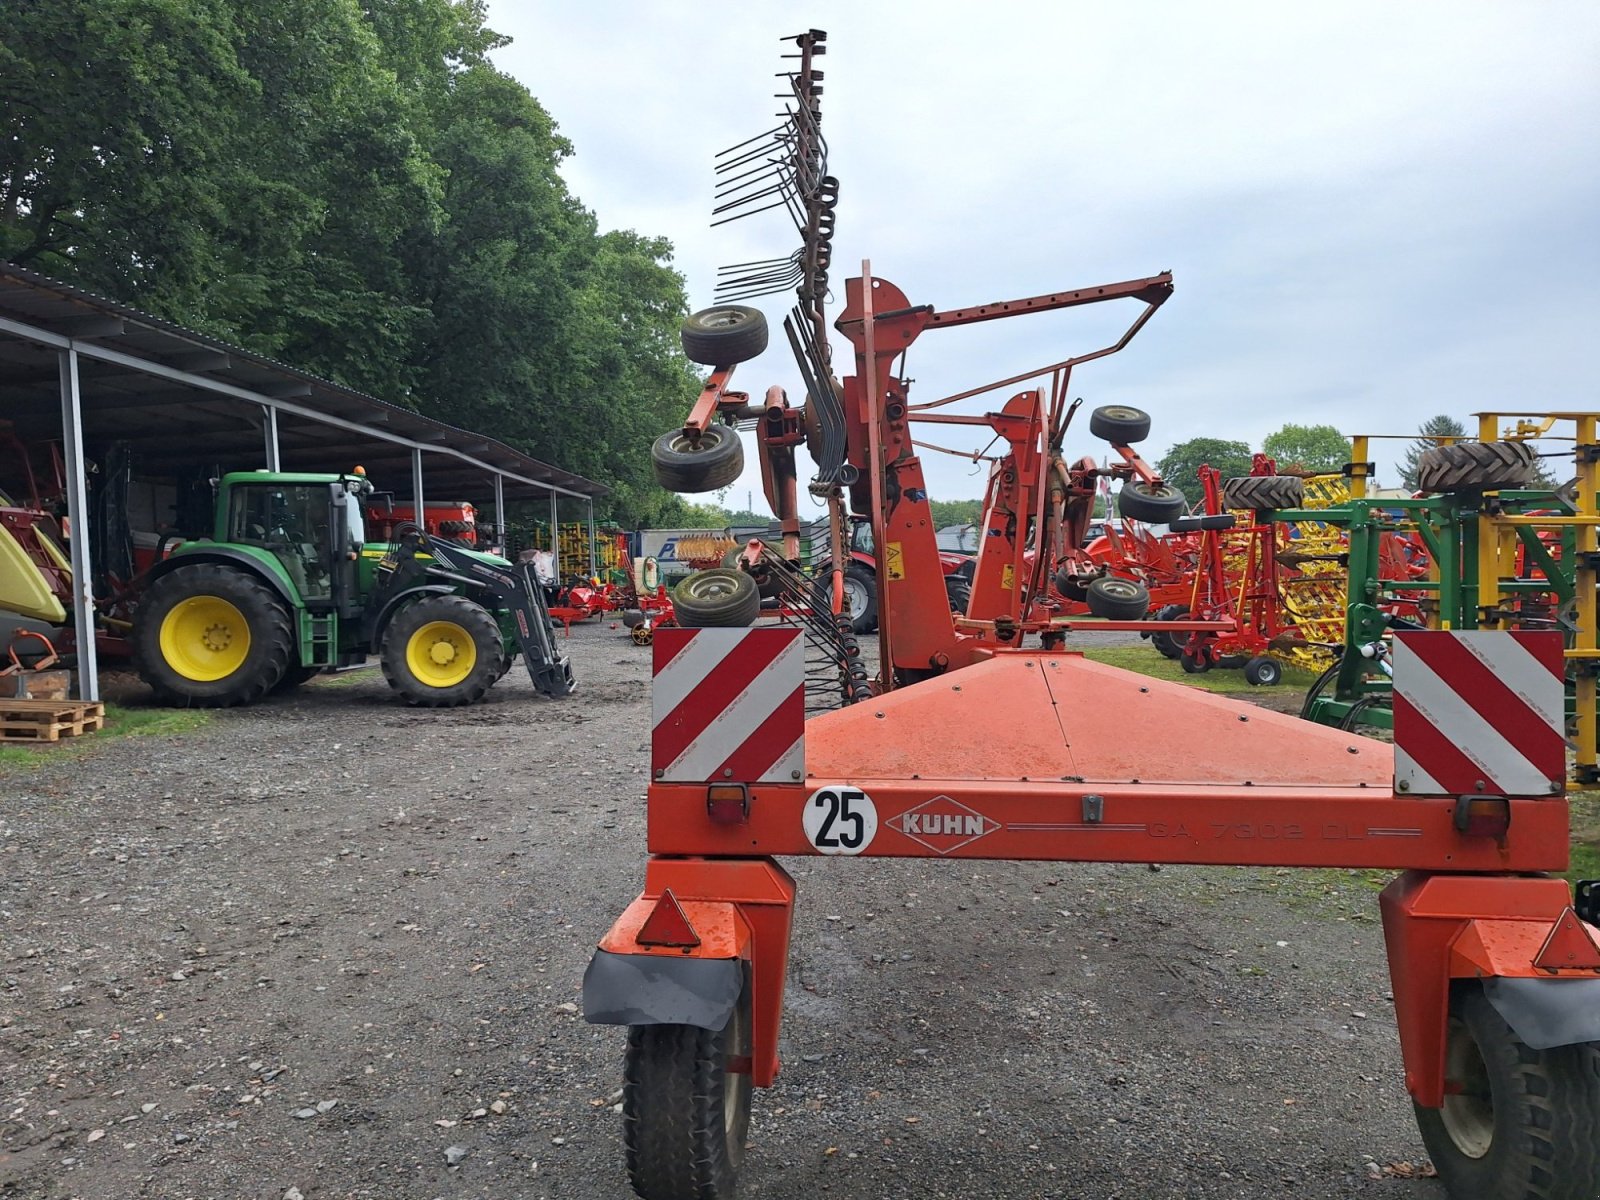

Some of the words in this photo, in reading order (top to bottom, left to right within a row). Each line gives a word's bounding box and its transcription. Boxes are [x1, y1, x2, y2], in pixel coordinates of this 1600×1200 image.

[815, 790, 865, 849] 25
[902, 813, 984, 836] KUHN
[1147, 822, 1191, 838] GA
[1204, 823, 1305, 840] 7302
